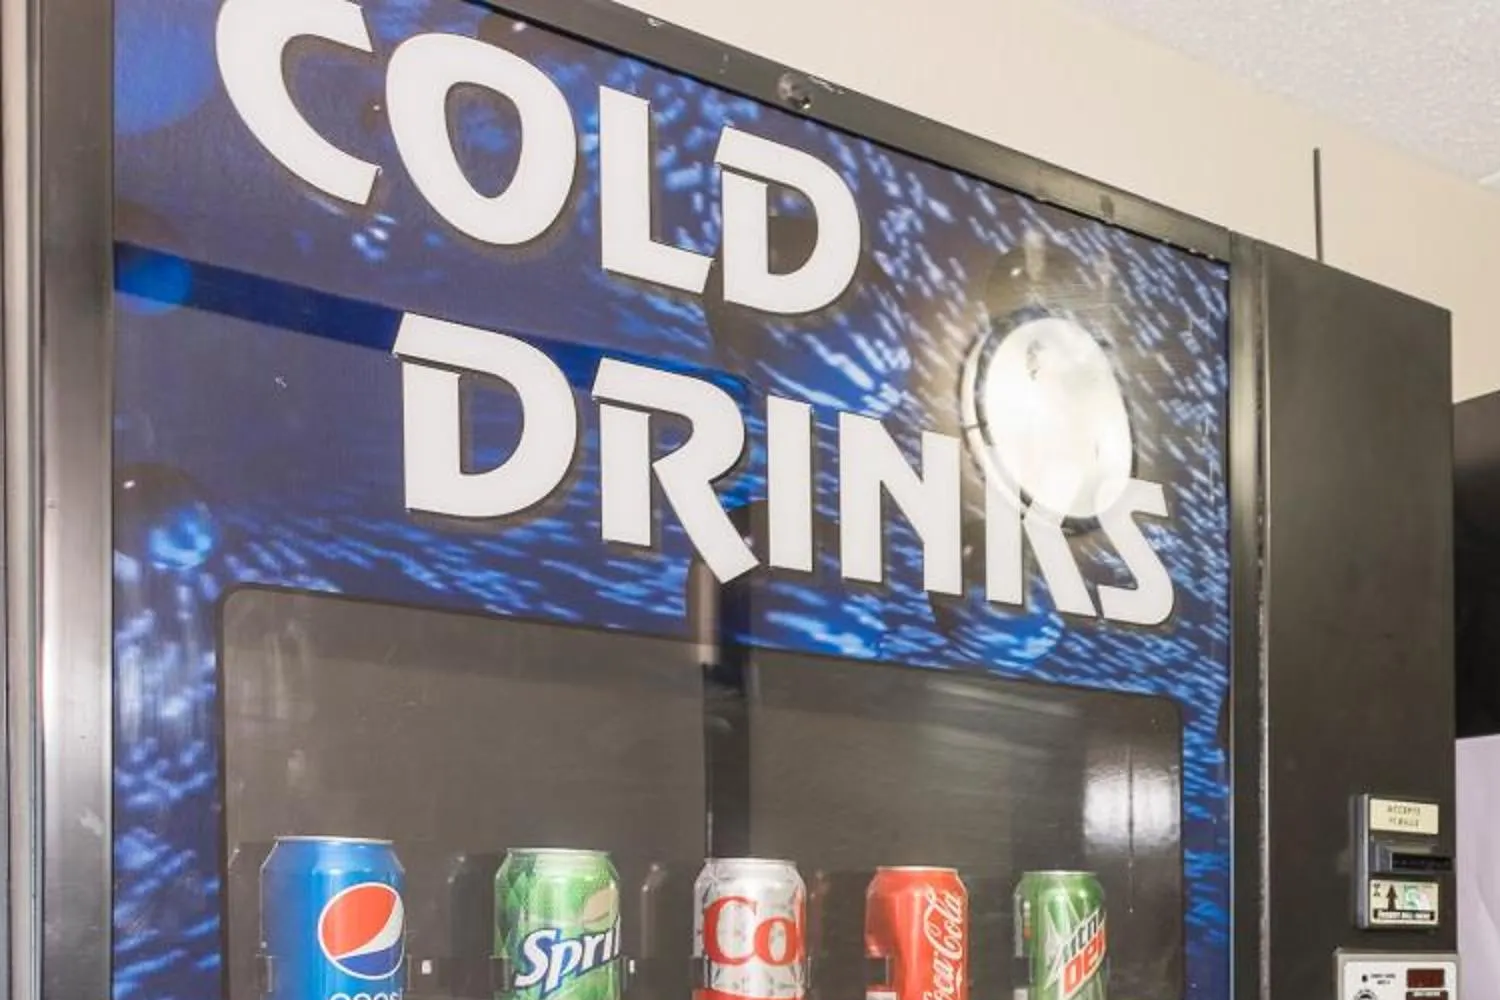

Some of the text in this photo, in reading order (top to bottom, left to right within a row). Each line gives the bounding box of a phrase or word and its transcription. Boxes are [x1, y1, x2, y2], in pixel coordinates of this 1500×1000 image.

[216, 0, 862, 314] COLD
[392, 311, 1174, 626] DRINKS
[702, 894, 806, 968] Co
